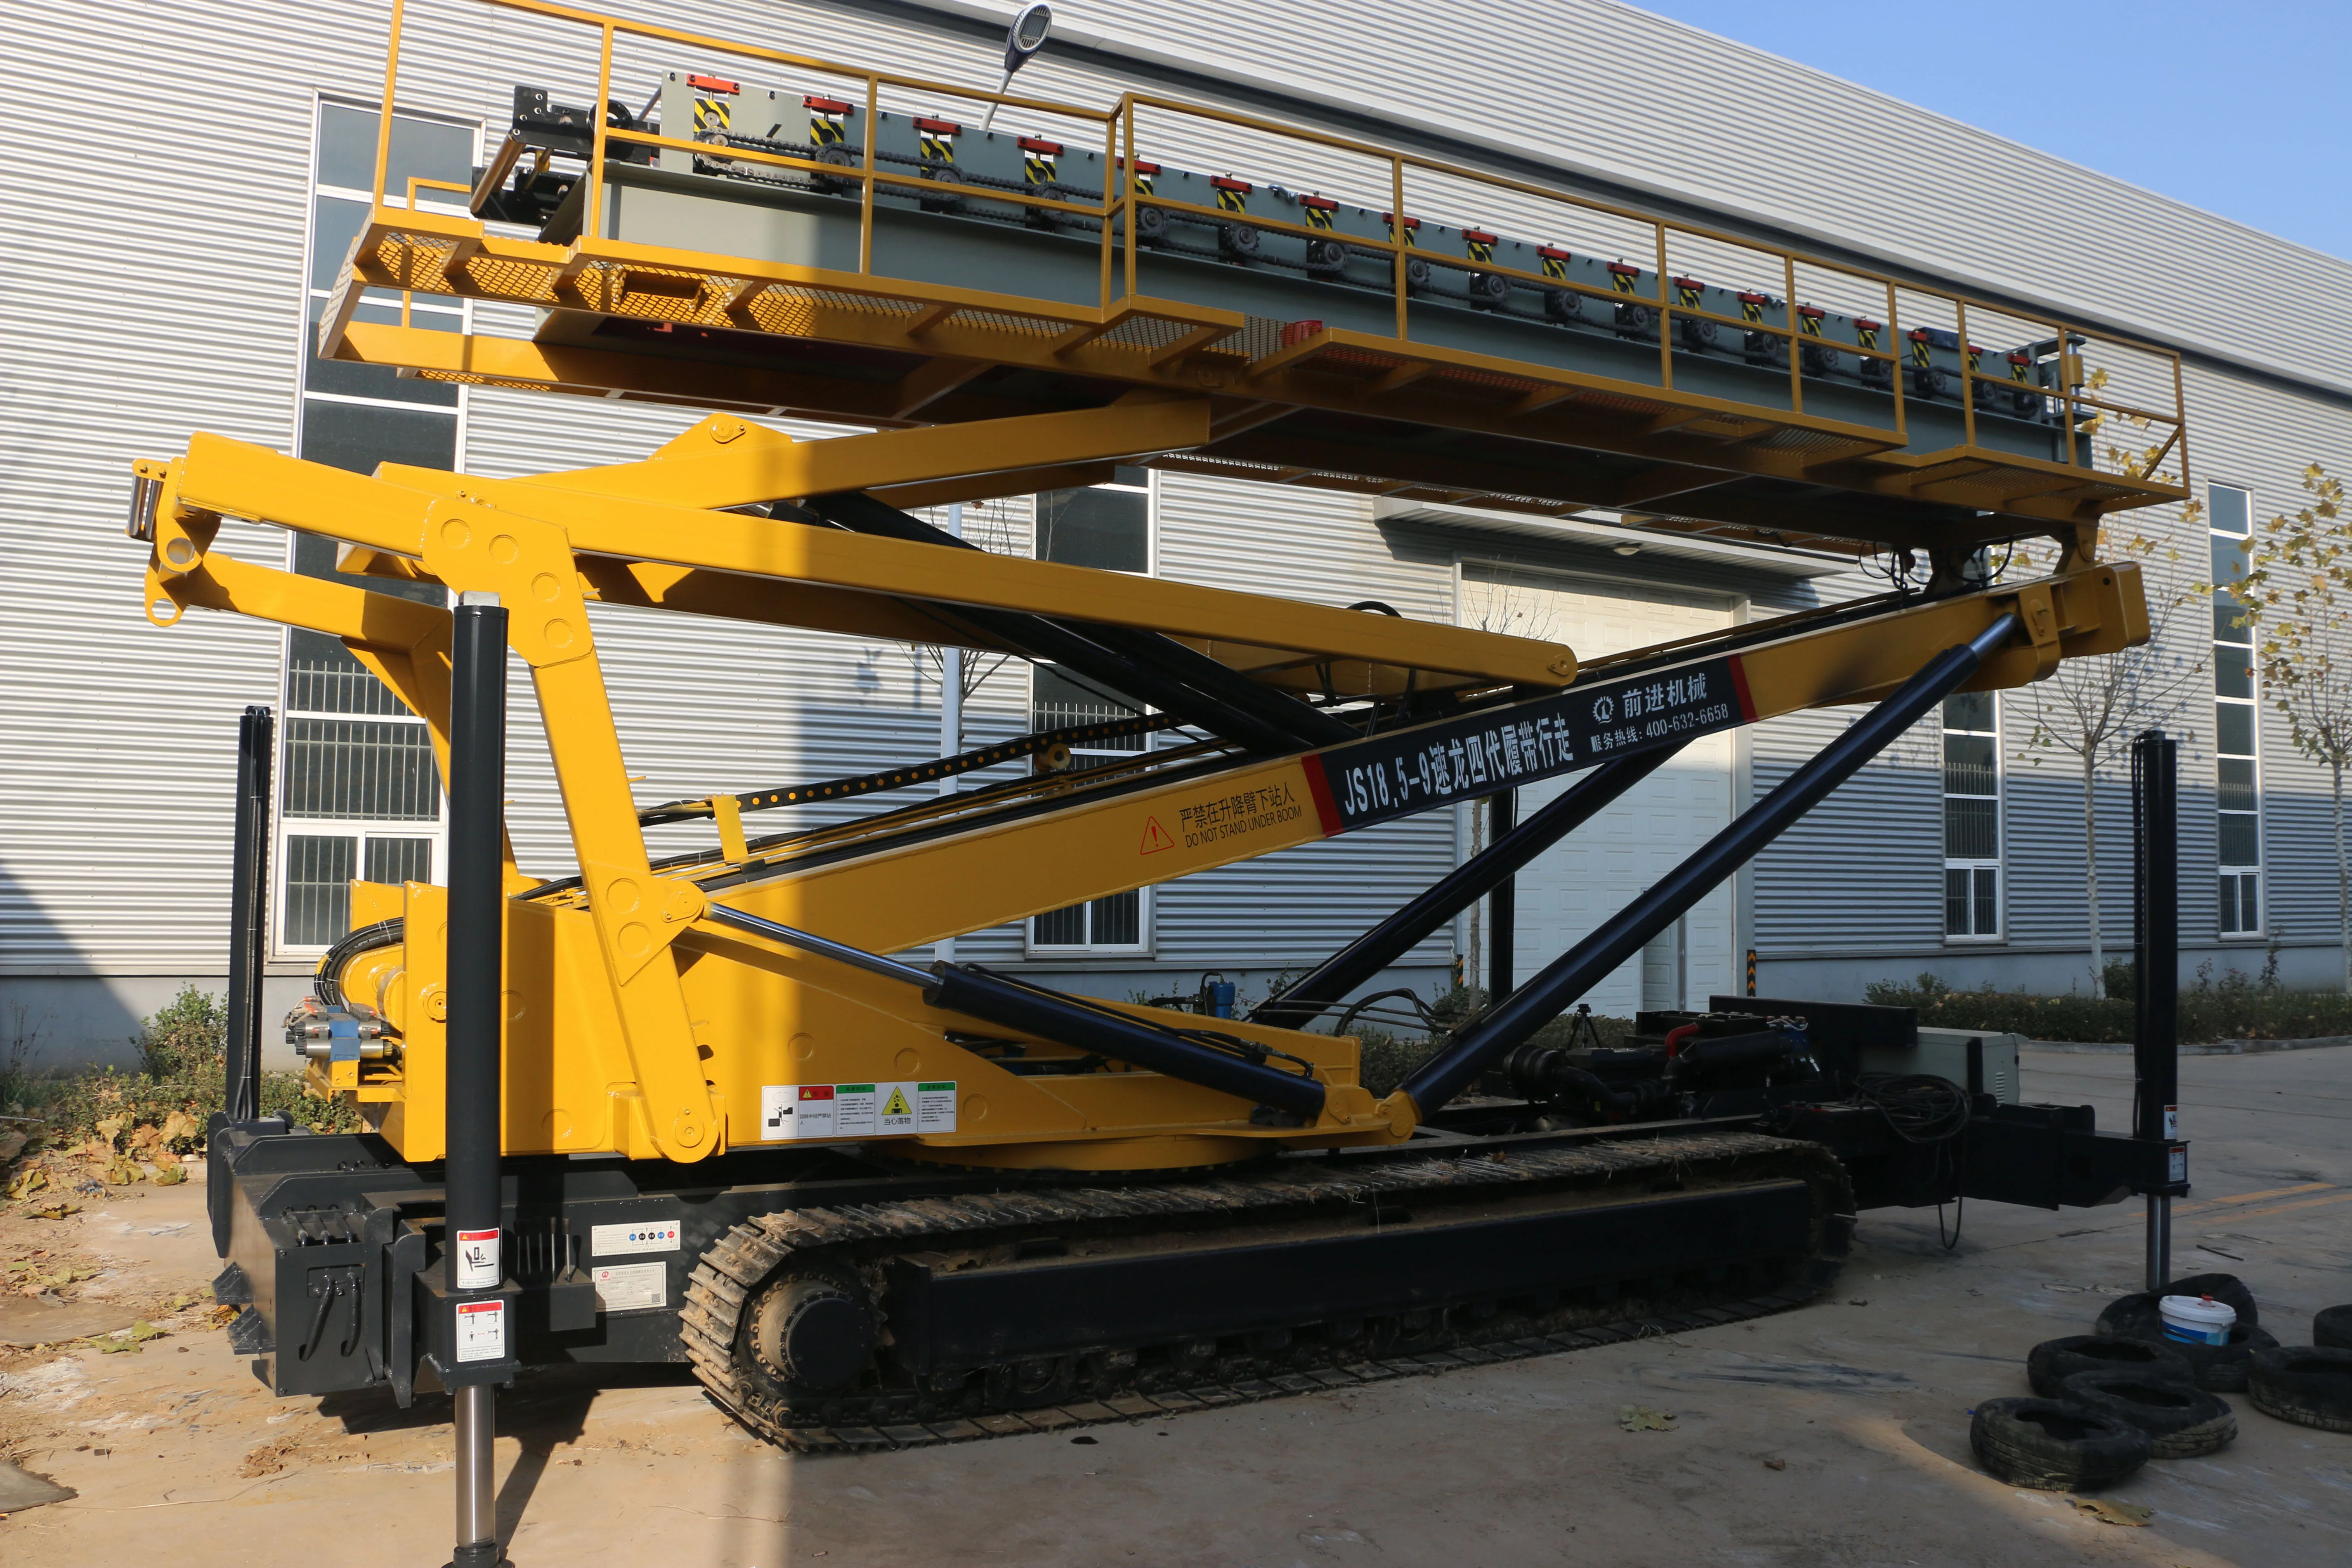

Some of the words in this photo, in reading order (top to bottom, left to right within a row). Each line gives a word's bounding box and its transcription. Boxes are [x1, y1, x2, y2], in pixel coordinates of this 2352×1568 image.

[1622, 672, 1707, 719] 前进机械
[1179, 782, 1295, 832] 严禁在升降臂下站人
[1185, 833, 1199, 848] DO
[1200, 827, 1218, 844] NOT
[1219, 820, 1247, 839] STAND
[1247, 812, 1276, 831] UNDER
[1276, 804, 1302, 823] BOOM
[884, 1117, 911, 1126] 当心落物
